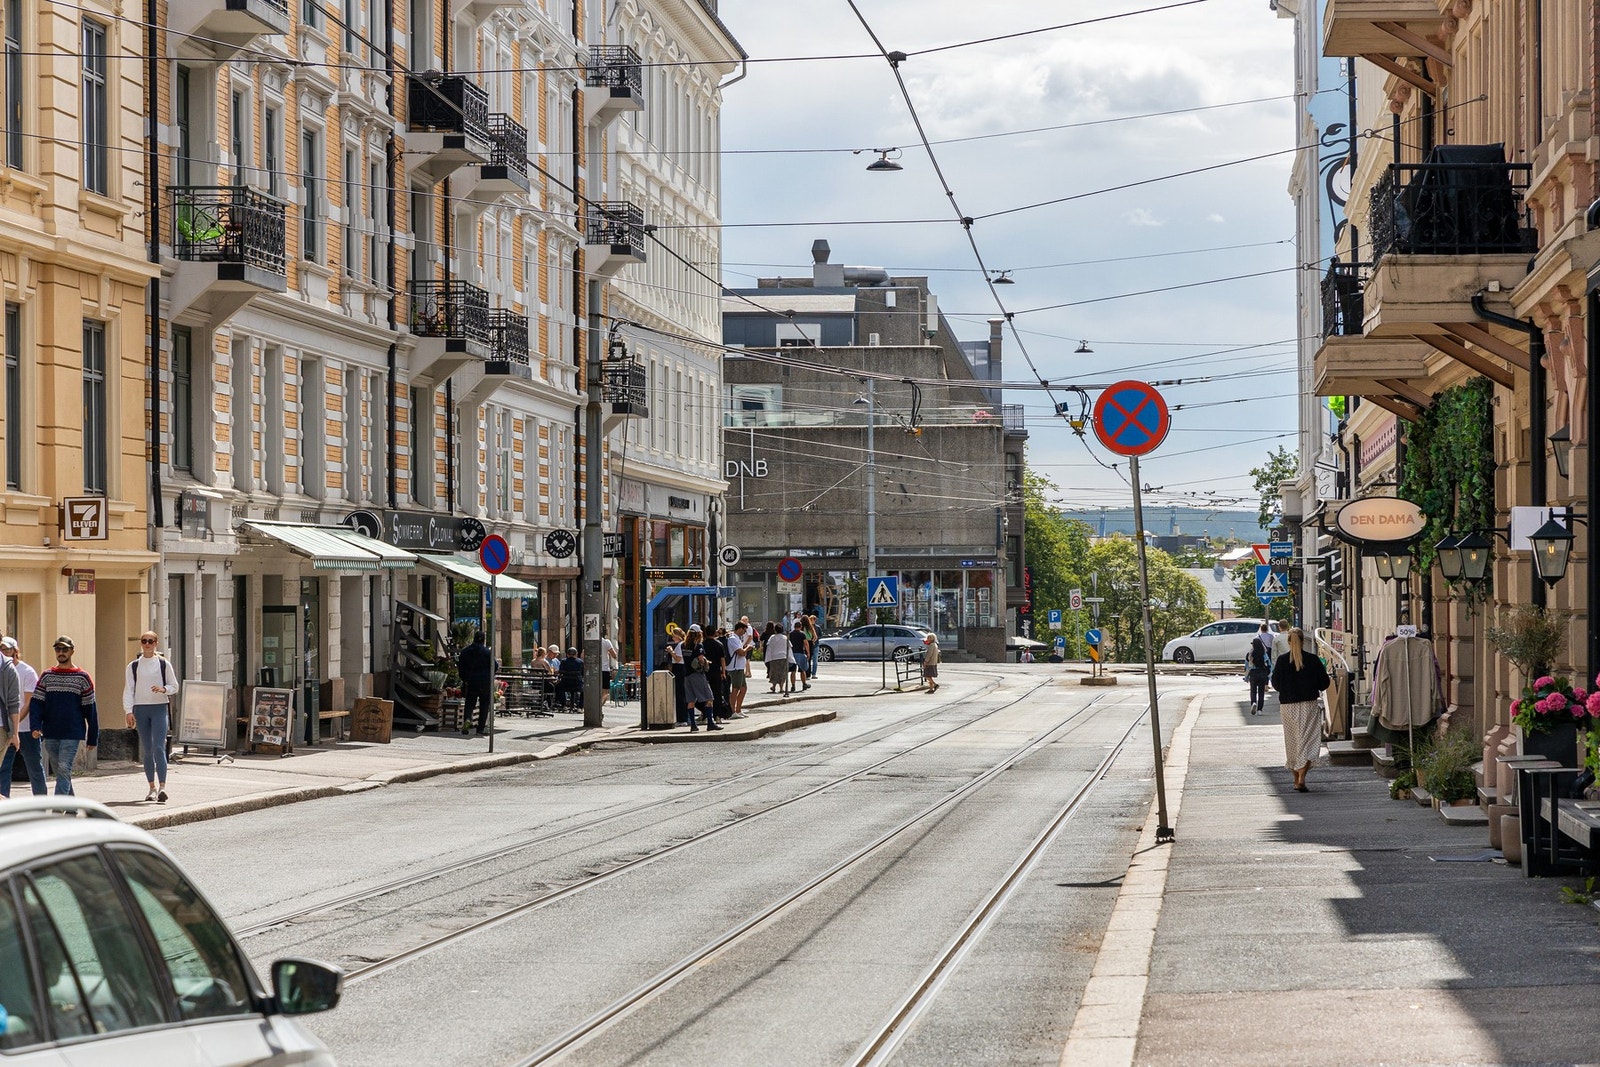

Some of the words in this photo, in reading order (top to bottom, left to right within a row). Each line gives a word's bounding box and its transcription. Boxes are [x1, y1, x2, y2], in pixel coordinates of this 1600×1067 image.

[73, 504, 97, 538] 7
[1350, 515, 1375, 525] DEN
[1378, 514, 1415, 525] DAMA
[1270, 557, 1288, 566] Solli
[1051, 611, 1059, 621] P
[1399, 628, 1415, 636] 50%
[1056, 637, 1064, 646] P
